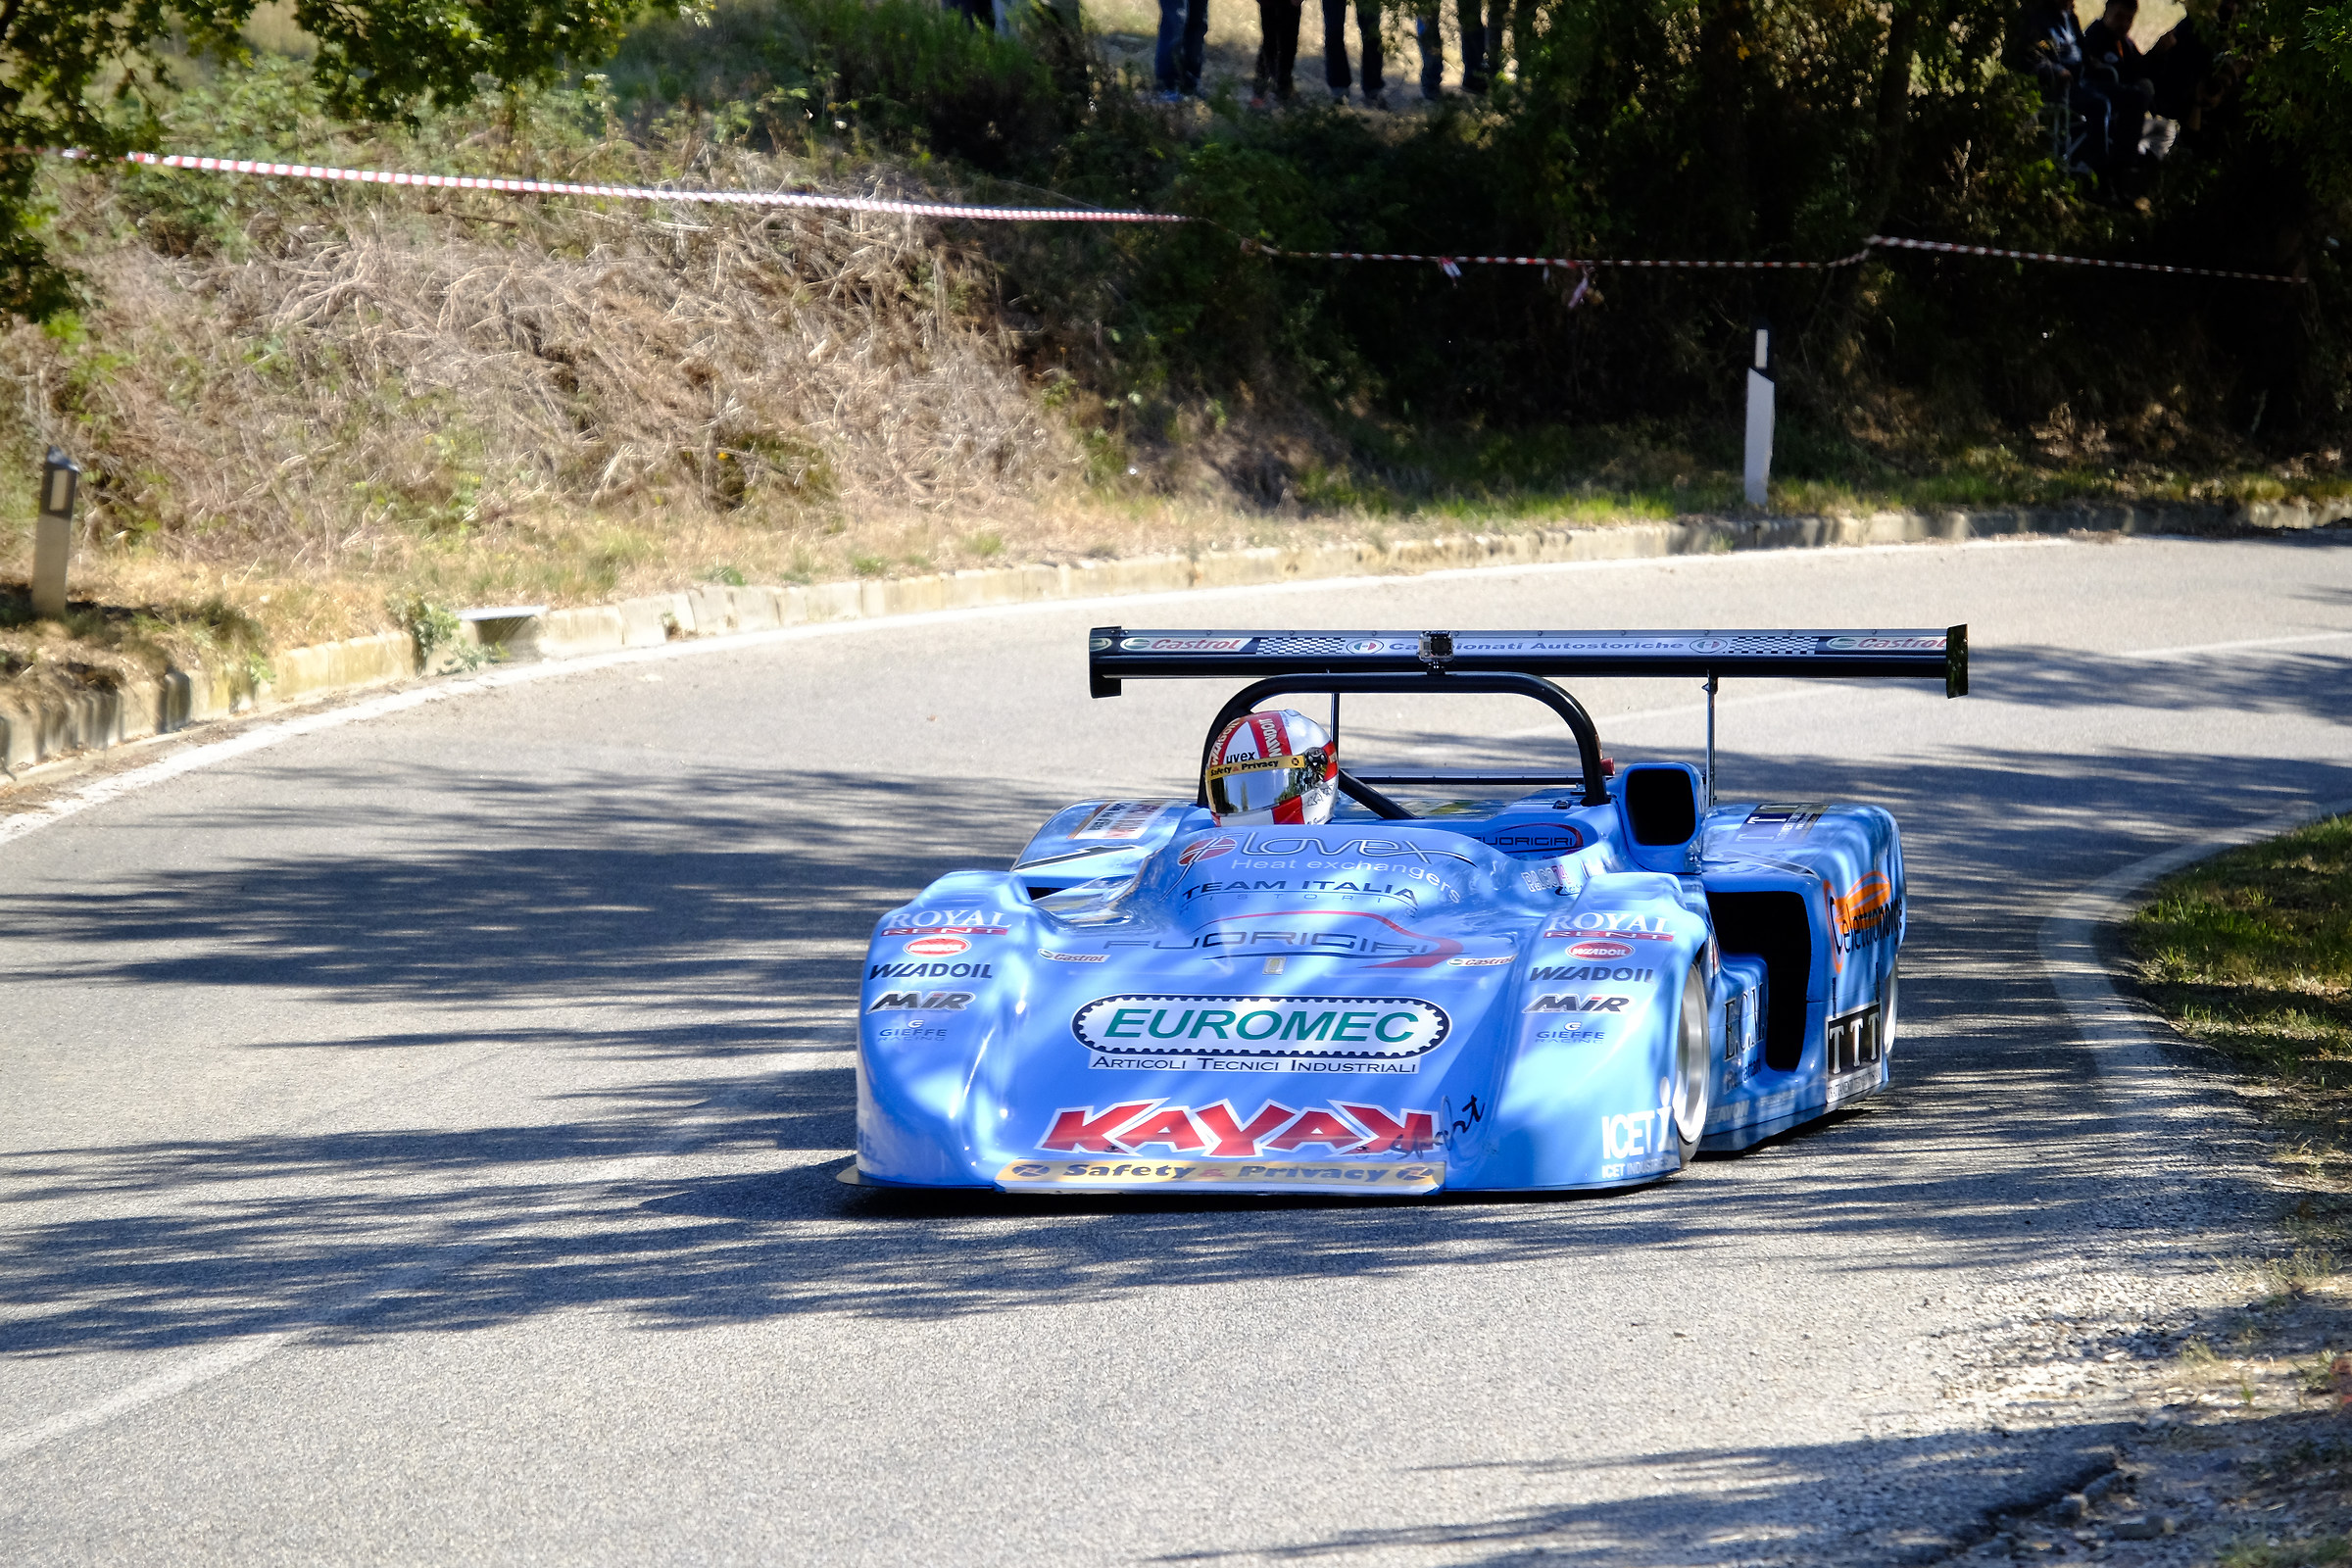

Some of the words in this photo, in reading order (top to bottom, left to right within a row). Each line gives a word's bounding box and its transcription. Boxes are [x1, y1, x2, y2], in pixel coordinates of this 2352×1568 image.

[1151, 638, 1240, 651] Castrol
[1531, 641, 1685, 650] Autostoriche
[1857, 638, 1946, 649] Castrol
[1226, 751, 1255, 764] uvex
[1210, 765, 1232, 777] Safety
[1241, 760, 1279, 771] Privacy
[1231, 858, 1297, 869] Heat
[1306, 859, 1461, 904] exchangers
[1182, 880, 1286, 901] TEAM
[1301, 880, 1418, 906] ITALIA
[886, 909, 1011, 928] ROYAL
[1545, 911, 1677, 934] ROYAL
[1103, 931, 1428, 954] FUORIGIRI
[1545, 931, 1672, 941] RENT
[1054, 954, 1104, 962] Castrol
[1465, 956, 1515, 965] Castrol
[1102, 1008, 1419, 1043] EUROMEC
[1536, 1031, 1605, 1040] GIEFFE
[1829, 1012, 1880, 1074] TTT
[1037, 1099, 1438, 1157] KAYAK
[1063, 1163, 1196, 1180] Safety
[1237, 1164, 1390, 1182] Privacy
